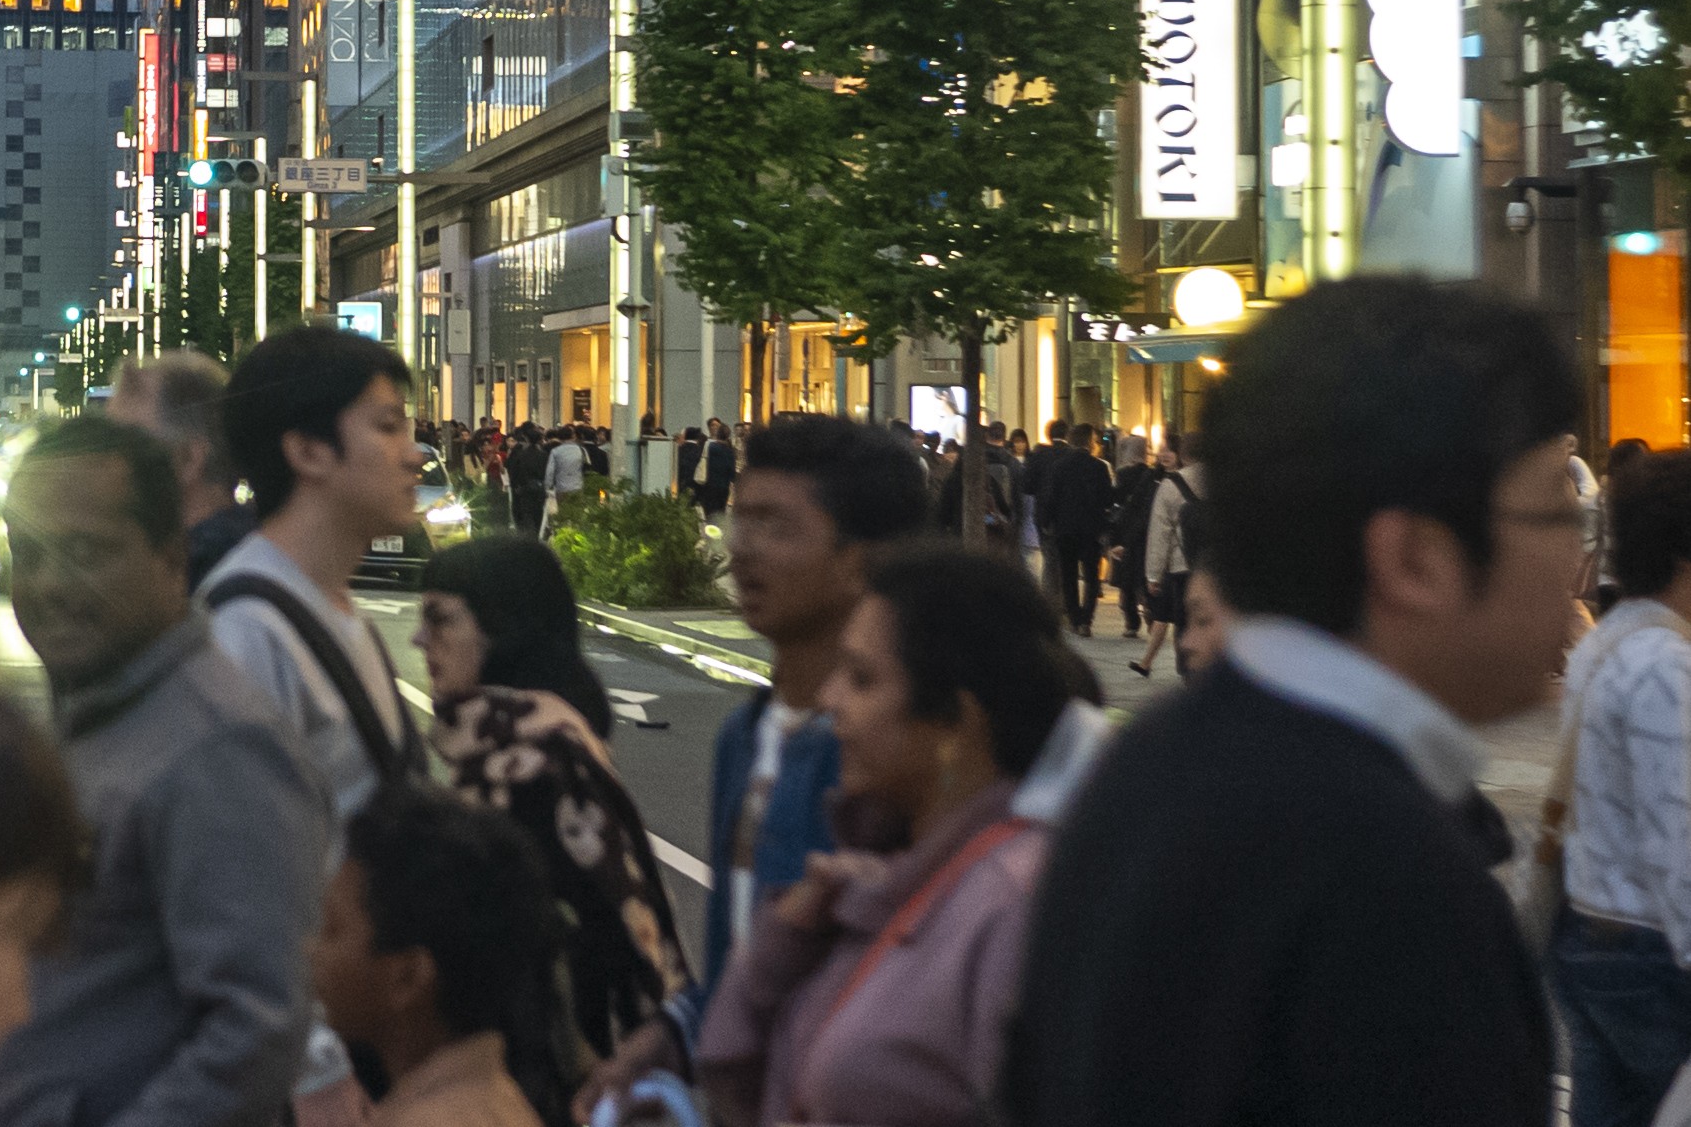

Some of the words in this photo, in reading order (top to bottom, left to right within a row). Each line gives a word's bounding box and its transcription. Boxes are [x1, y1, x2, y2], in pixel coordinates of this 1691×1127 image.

[285, 167, 360, 181] 銀座三丁目
